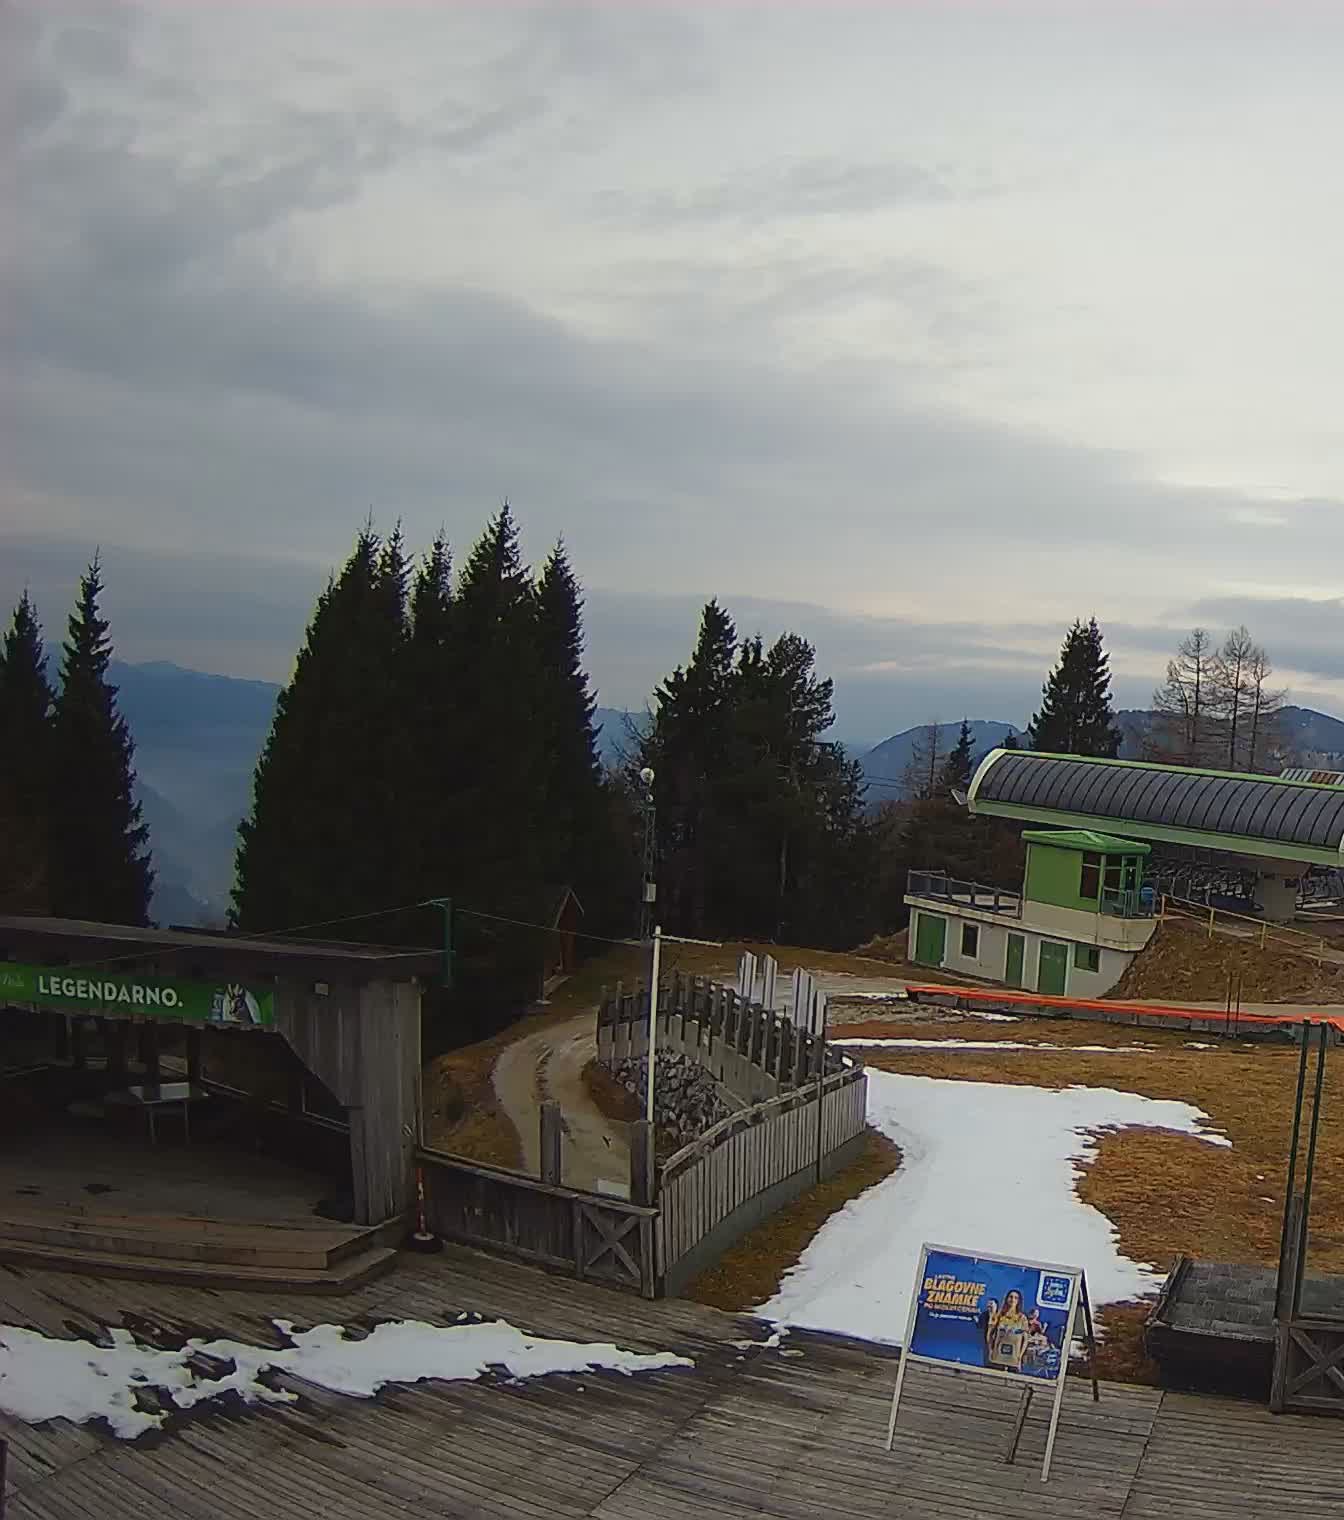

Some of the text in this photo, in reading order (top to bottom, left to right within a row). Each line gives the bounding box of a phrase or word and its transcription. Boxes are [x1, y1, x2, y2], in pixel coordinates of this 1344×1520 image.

[38, 975, 183, 1008] LEGENDARNO.
[924, 1278, 986, 1295] BLAGOVNE
[927, 1290, 980, 1306] ZNAMKE
